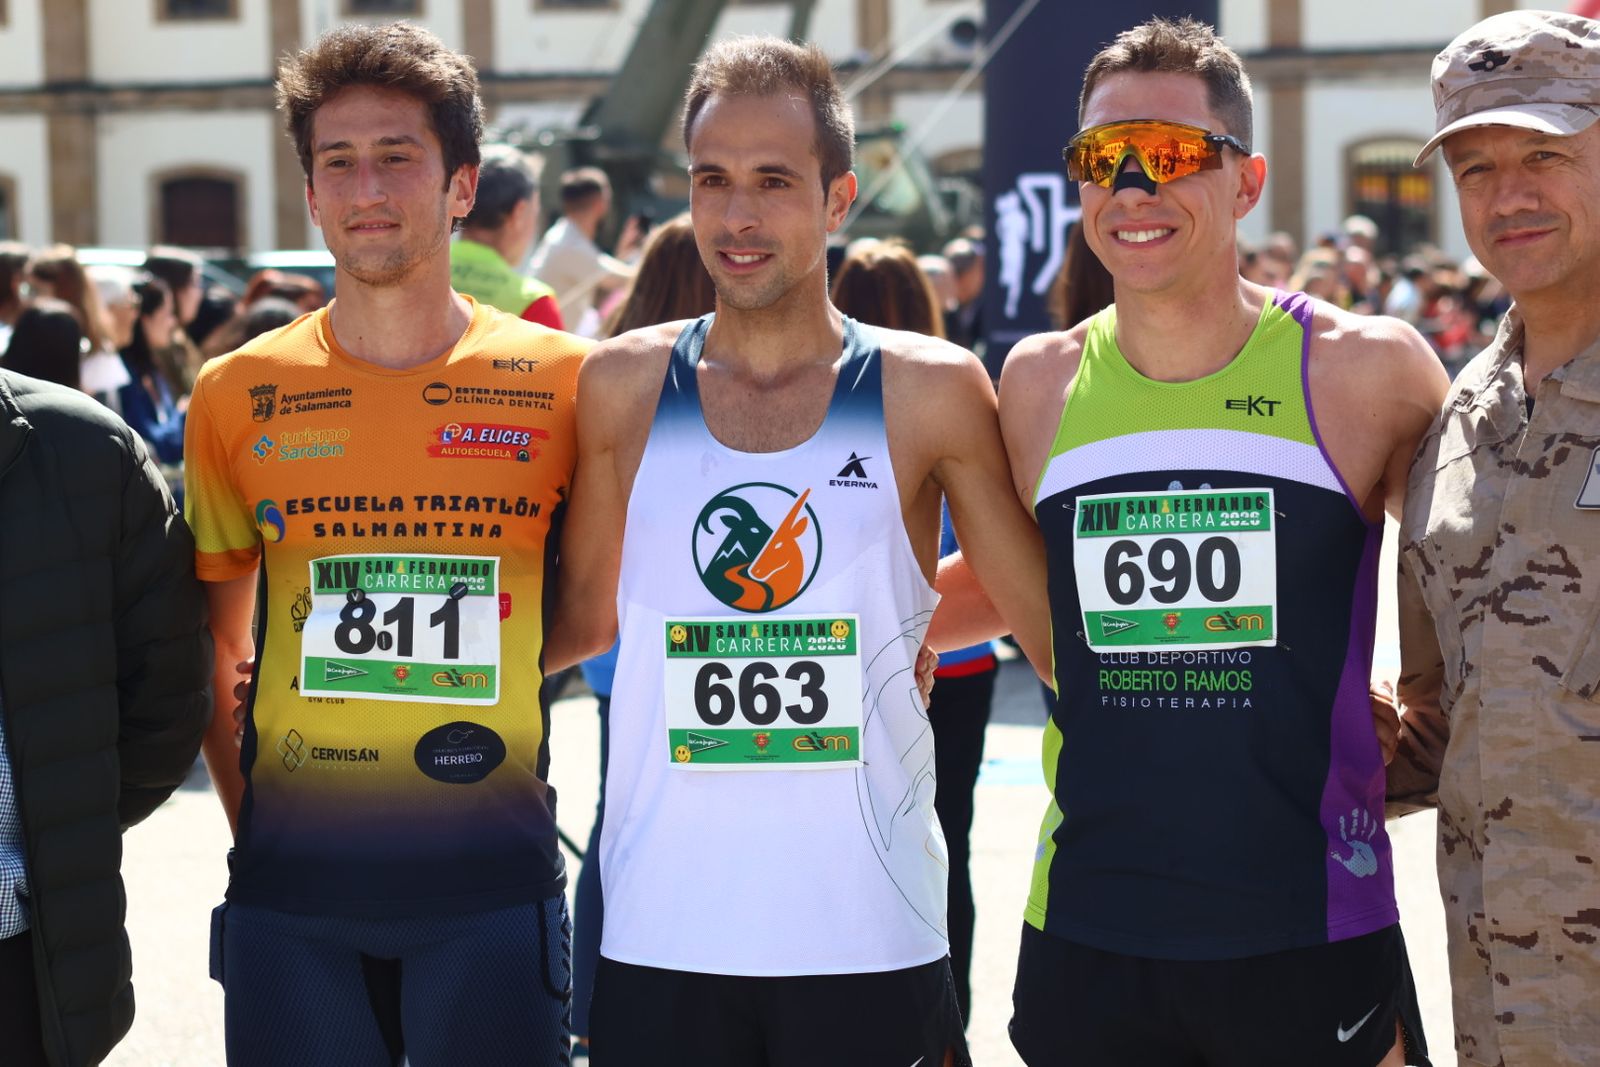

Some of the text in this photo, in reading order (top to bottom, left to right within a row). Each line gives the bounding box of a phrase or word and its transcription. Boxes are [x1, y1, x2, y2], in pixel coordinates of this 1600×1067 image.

[280, 387, 353, 405] Ayuntamiento
[455, 387, 556, 400] ESTER RODRÍGUEZ
[279, 399, 352, 415] de Salamanca
[454, 394, 554, 411] CLÍNICA DENTAL
[1225, 395, 1282, 416] EKT
[280, 427, 351, 445] turismo
[461, 427, 531, 446] A. ELICES
[278, 441, 344, 461] Sardón
[440, 447, 512, 458] AUTOESCUELA
[829, 479, 878, 489] EVERNYA
[286, 495, 540, 518] ESCUELA TRIATLÓN
[1080, 496, 1265, 532] XIV SAN FERNANDO
[1126, 512, 1216, 530] CARRERA
[313, 522, 502, 538] SALMANTINA
[317, 560, 490, 589] XIV SAN FERNANDO
[1103, 536, 1241, 605] 690
[364, 574, 446, 589] CARRERA
[334, 596, 460, 659] 811
[716, 624, 747, 638] SAN
[763, 621, 839, 638] FERNAN
[716, 637, 803, 653] CARRERA
[1099, 651, 1252, 664] CLUB DEPORTIVO
[1099, 670, 1252, 691] ROBERTO RAMOS
[694, 660, 829, 726] 663
[1101, 696, 1253, 708] FISIOTERAPIA
[311, 746, 380, 762] CERVISÁN
[434, 752, 483, 766] HERRERO
